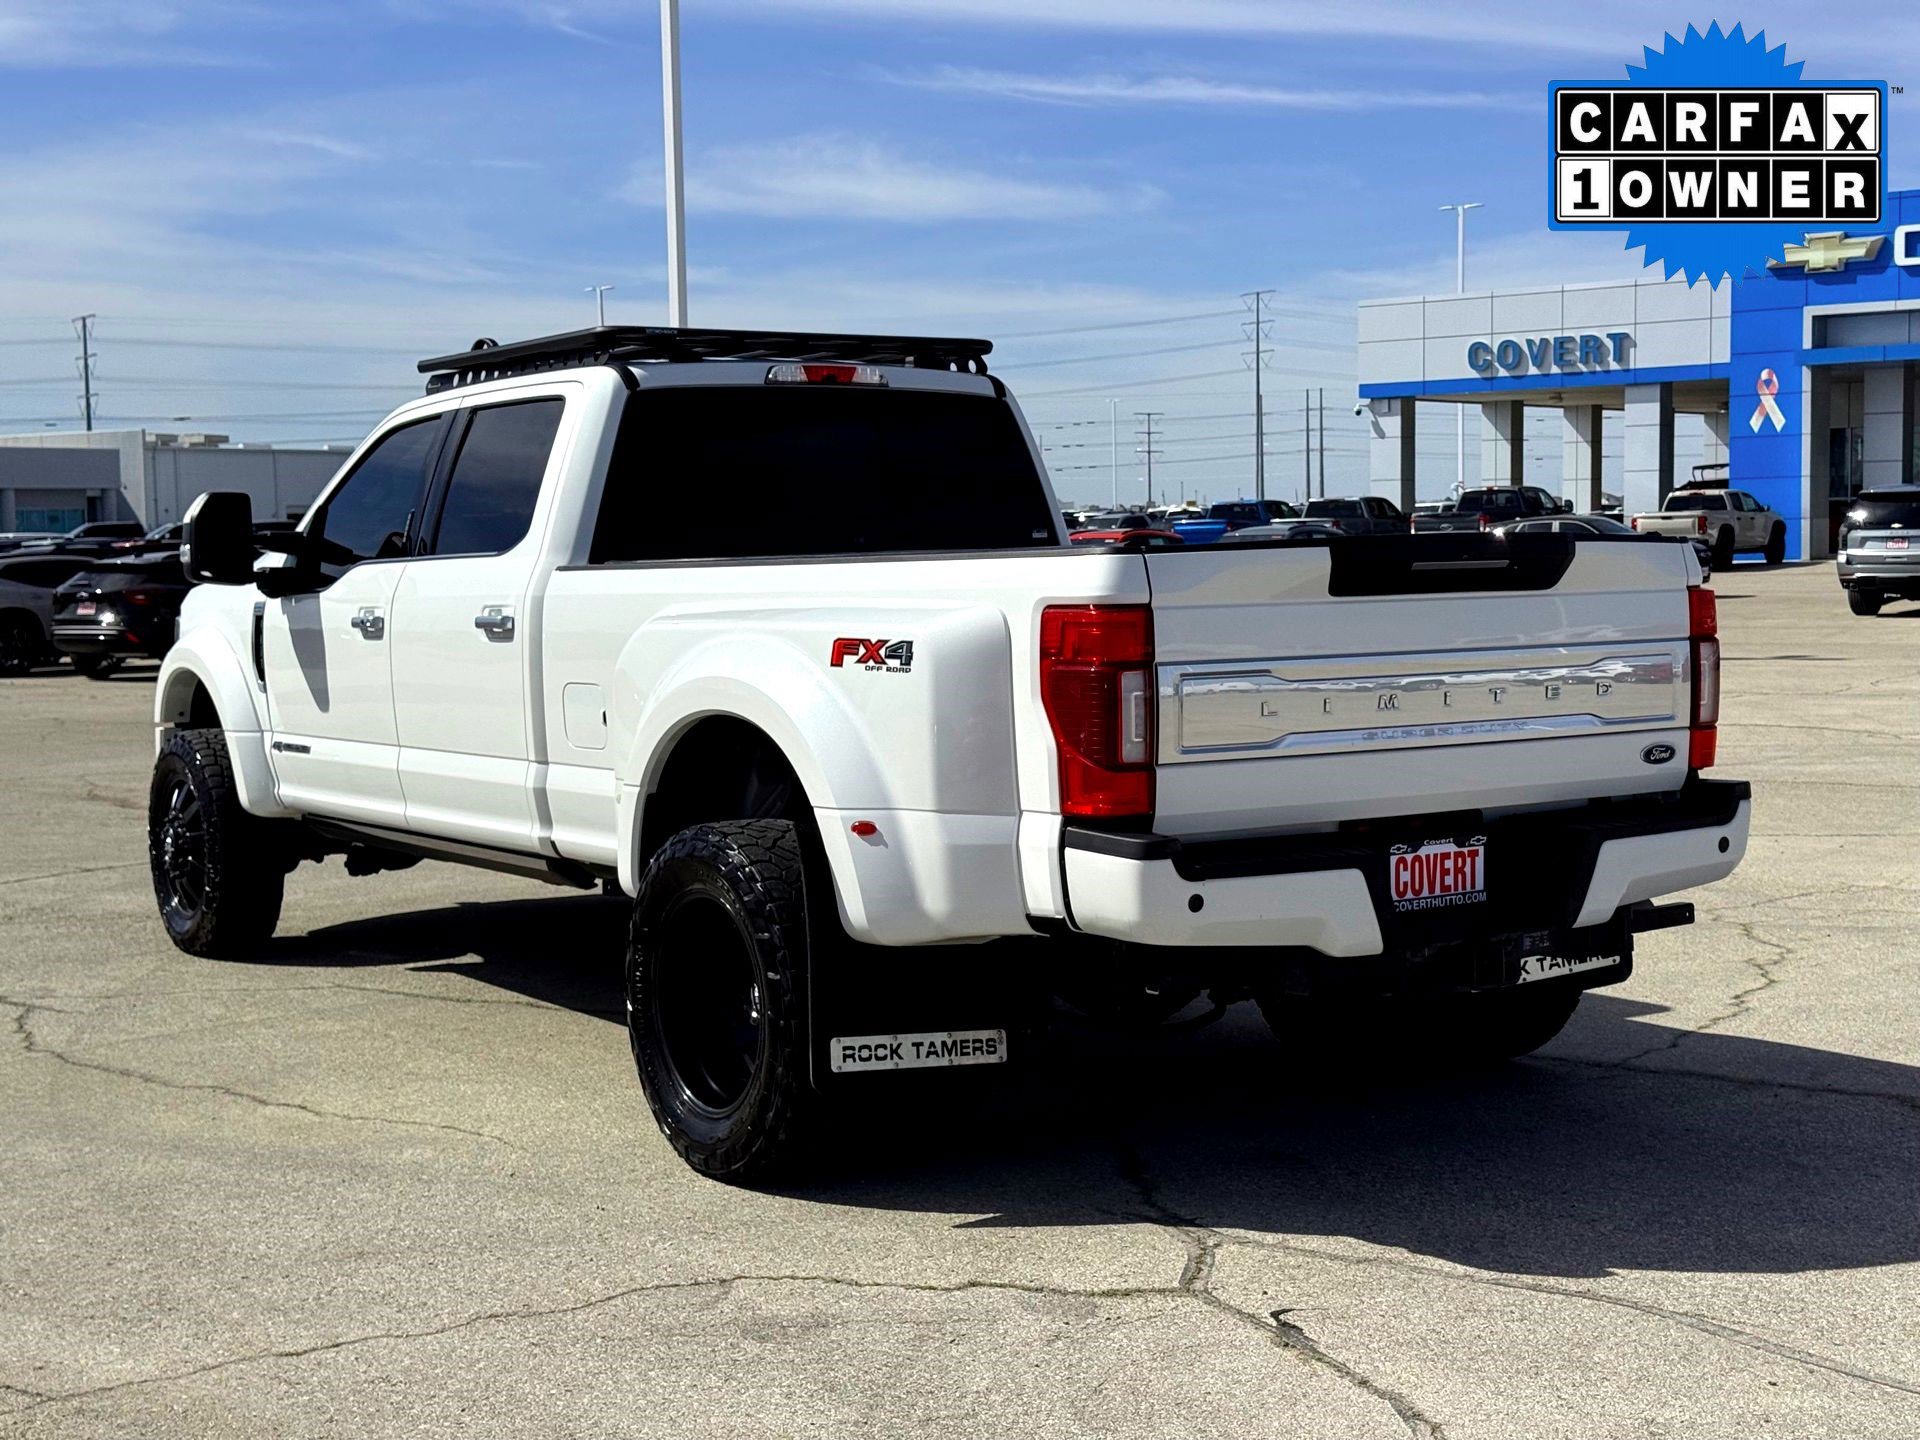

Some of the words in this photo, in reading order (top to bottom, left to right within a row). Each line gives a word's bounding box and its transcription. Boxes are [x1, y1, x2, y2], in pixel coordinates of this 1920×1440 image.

[1467, 332, 1630, 372] COVERT
[830, 637, 914, 668] FX4
[885, 666, 912, 674] ROAD
[1261, 682, 1612, 717] LIMITED
[1650, 747, 1671, 760] Ford
[1423, 837, 1454, 846] Covert
[1395, 849, 1480, 899] COVERT
[842, 1042, 904, 1064] ROCK
[911, 1037, 998, 1060] TAMERS
